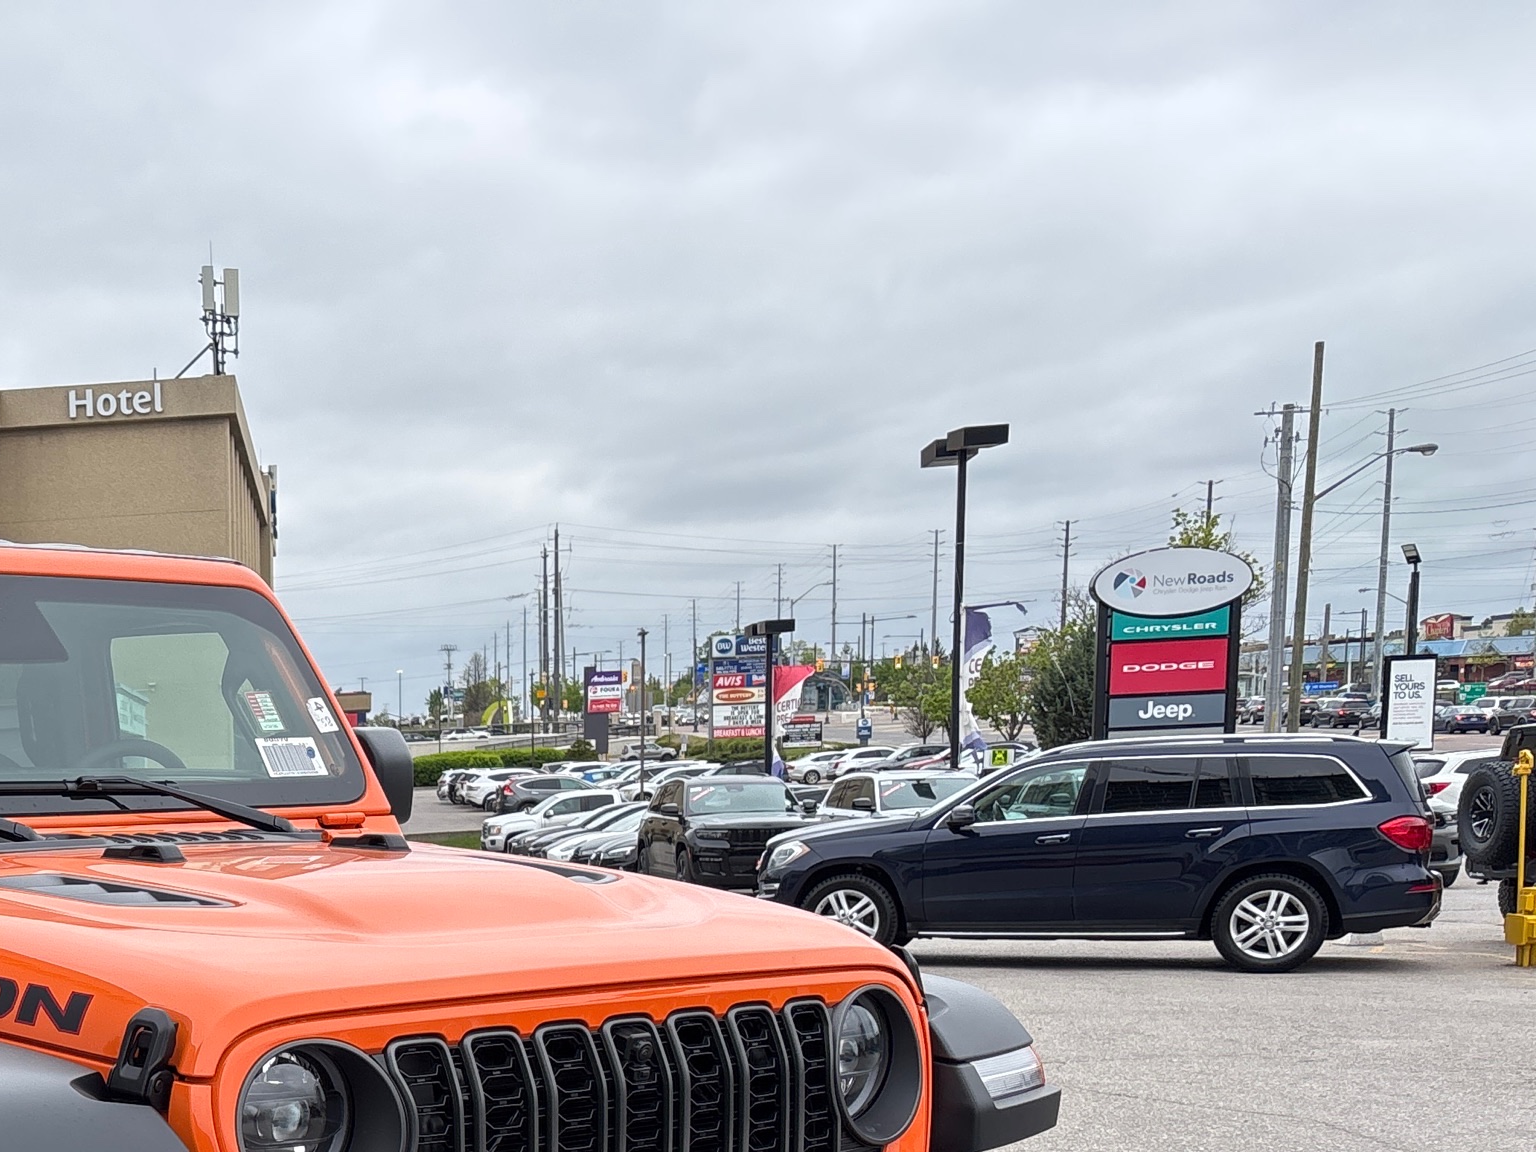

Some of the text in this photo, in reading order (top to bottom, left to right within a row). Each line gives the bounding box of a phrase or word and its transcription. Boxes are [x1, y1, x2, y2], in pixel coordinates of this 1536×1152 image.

[68, 382, 164, 418] Hotel
[1152, 586, 1177, 595] Chrysler
[1178, 586, 1199, 594] Dodge
[1122, 622, 1218, 634] CHRYSLER
[740, 644, 767, 653] Weste
[1122, 660, 1215, 673] DODGE
[716, 676, 742, 687] AVIS
[1394, 673, 1415, 683] SELL
[1393, 682, 1426, 691] YOURS
[1393, 690, 1422, 700] TO US.
[1138, 700, 1193, 721] Jeep
[713, 728, 742, 738] BREAKFAST
[745, 728, 762, 737] LUNCH
